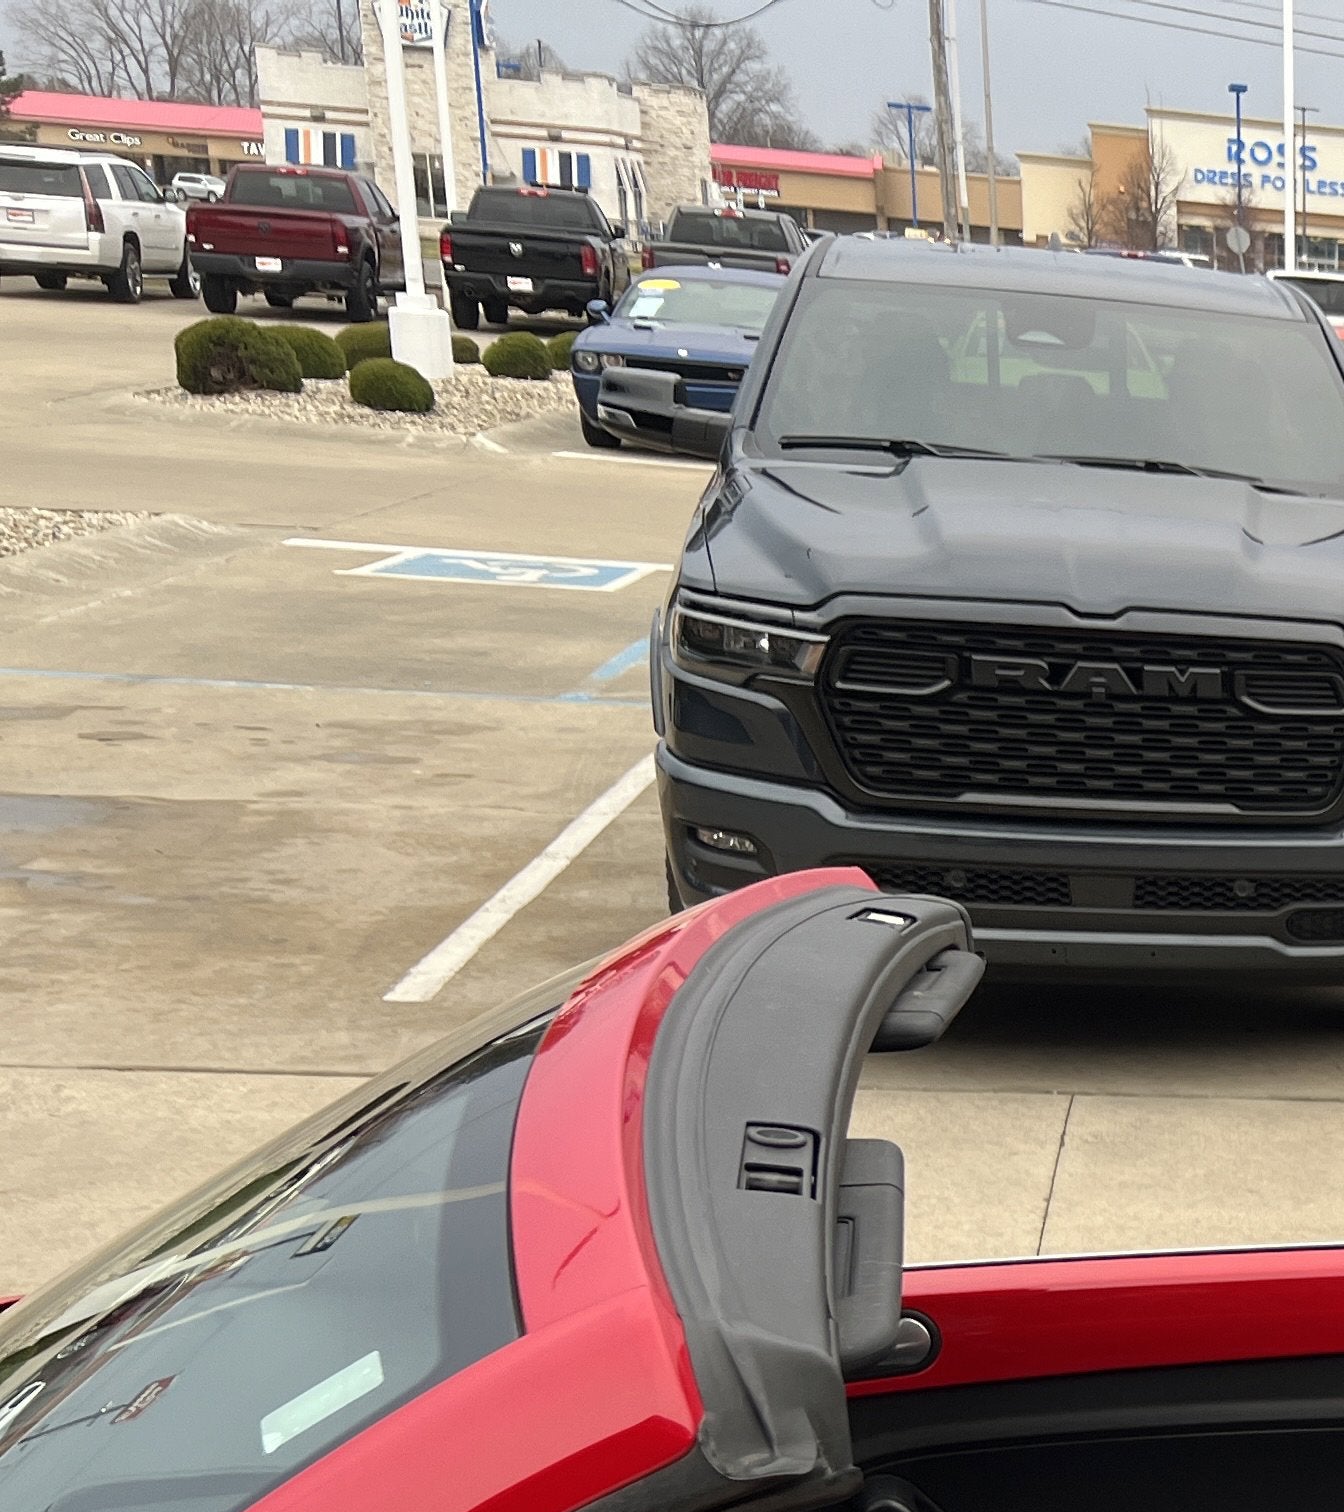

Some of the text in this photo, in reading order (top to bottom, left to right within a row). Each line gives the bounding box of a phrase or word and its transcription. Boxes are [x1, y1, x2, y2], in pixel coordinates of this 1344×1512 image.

[67, 128, 143, 148] Great Clips
[1194, 168, 1254, 188] DRESS
[968, 653, 1223, 698] RAM
